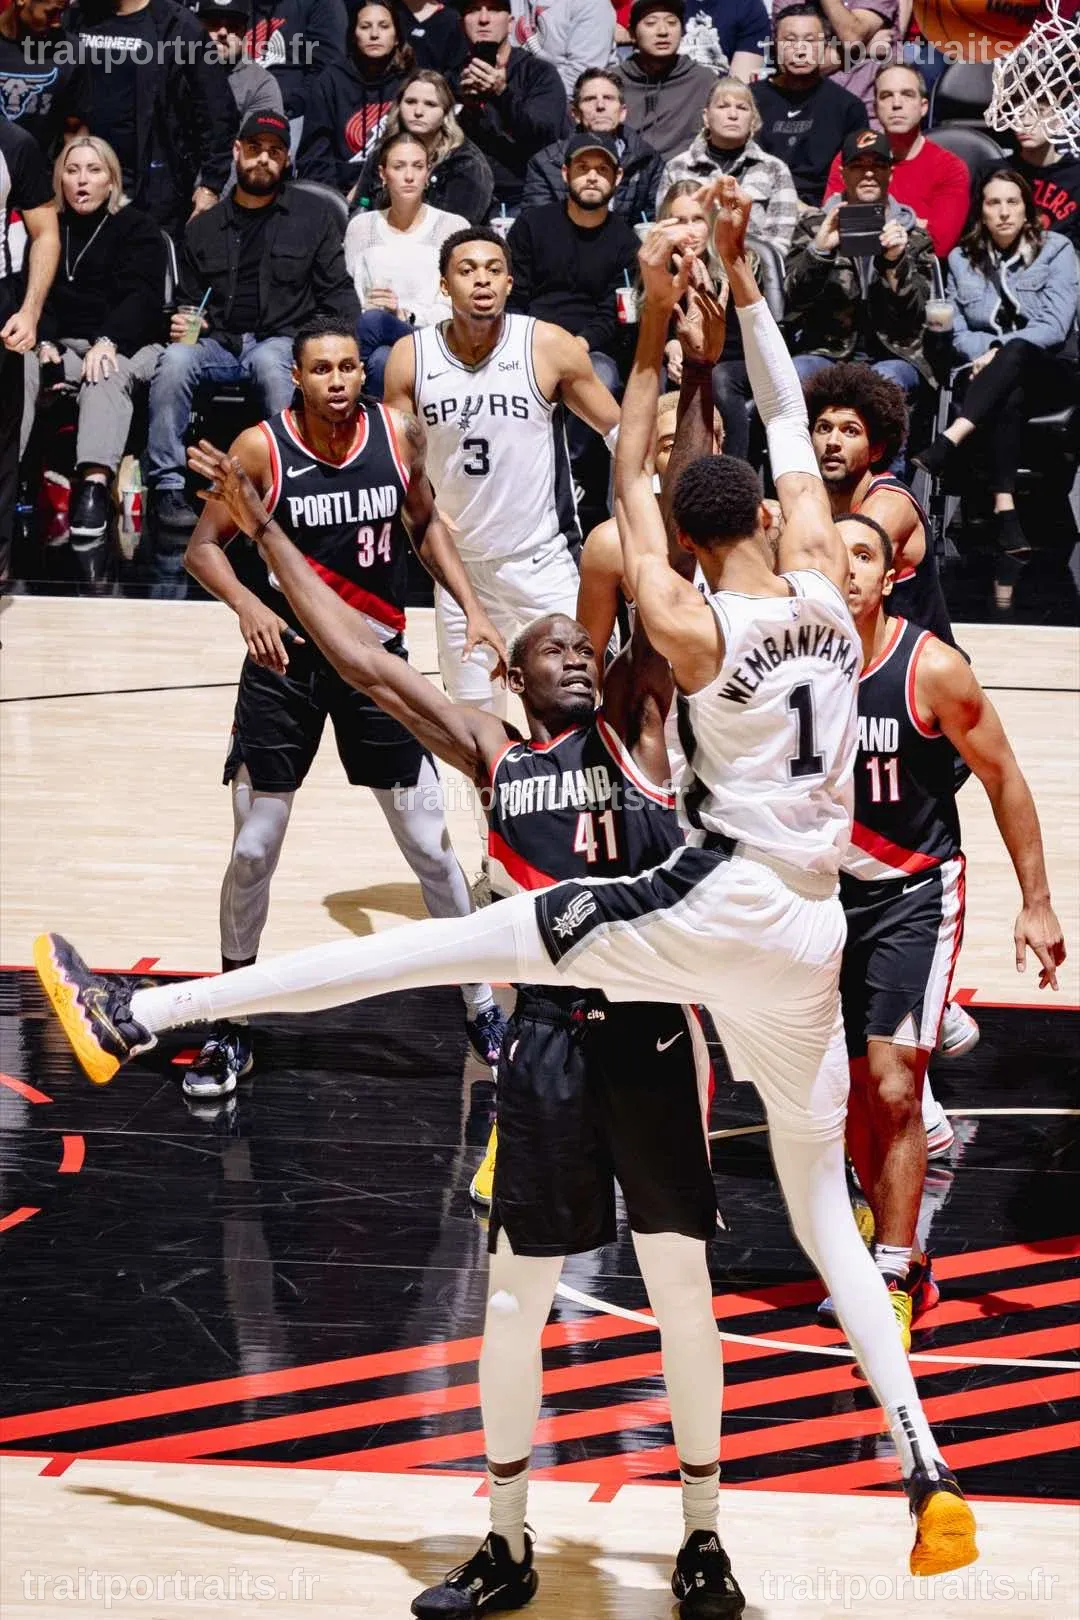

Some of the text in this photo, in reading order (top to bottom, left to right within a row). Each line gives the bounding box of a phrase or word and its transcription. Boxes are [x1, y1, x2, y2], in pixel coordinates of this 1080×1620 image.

[1033, 179, 1077, 220] ZERS
[498, 360, 522, 372] Self.
[422, 393, 529, 431] SPURS
[462, 438, 490, 477] 3
[286, 485, 398, 528] PORTLAND
[357, 522, 393, 568] 34
[717, 625, 859, 705] WEMBANYAMA
[785, 679, 828, 783] 1
[499, 765, 612, 821] PORTLAND
[865, 756, 901, 803] 11
[572, 808, 619, 864] 41
[586, 1008, 606, 1021] city
